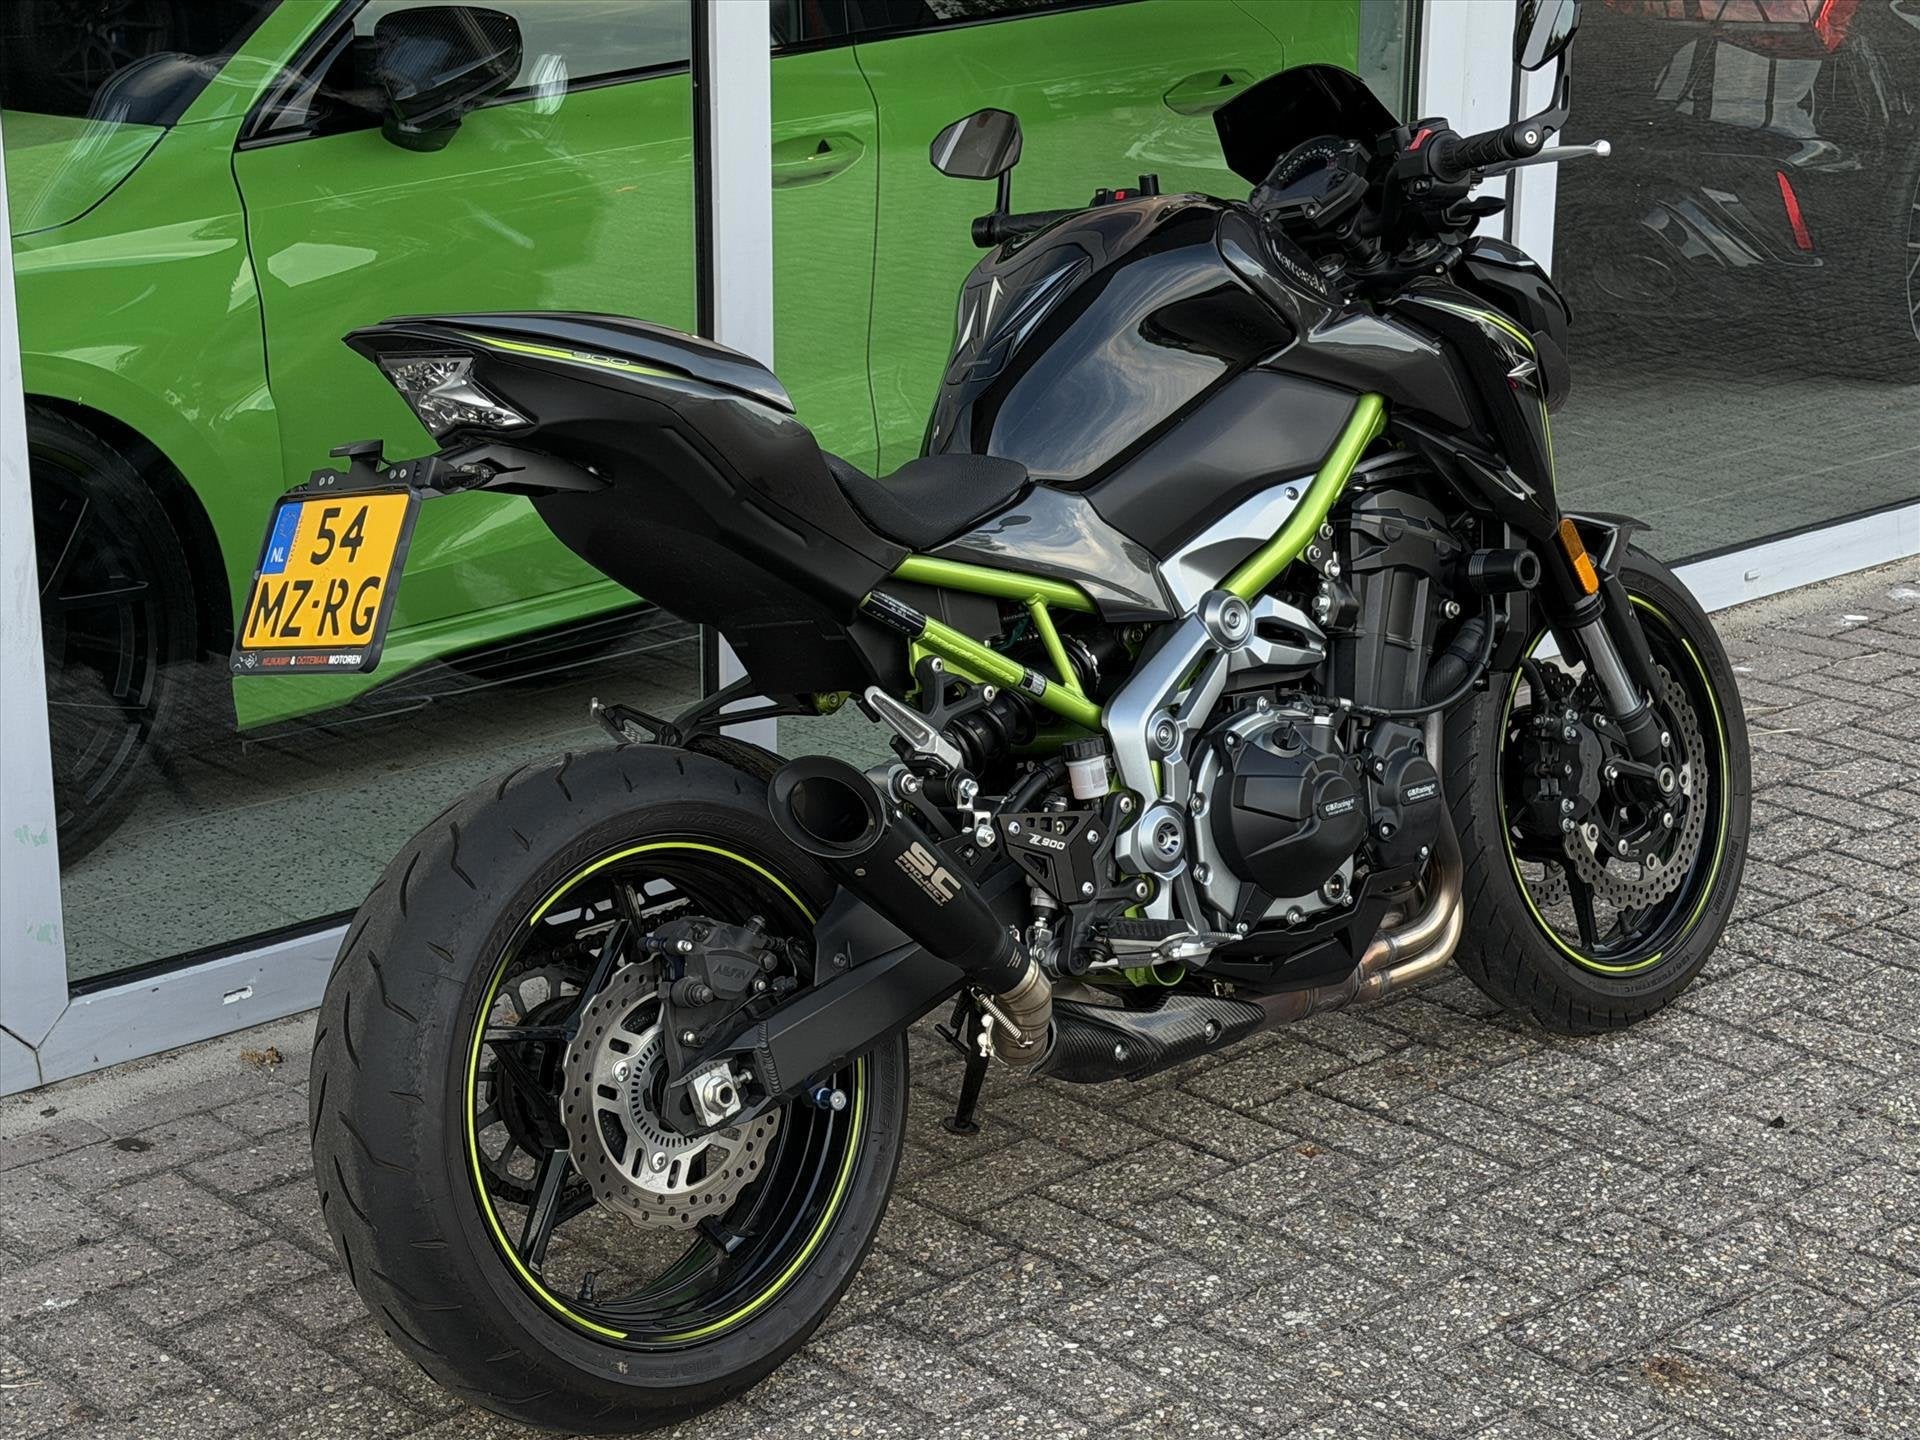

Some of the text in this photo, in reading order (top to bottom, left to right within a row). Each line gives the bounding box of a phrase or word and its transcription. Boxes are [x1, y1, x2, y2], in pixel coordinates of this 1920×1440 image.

[270, 547, 284, 563] NL
[310, 505, 369, 566] 54
[248, 575, 382, 639] MZ-RG
[290, 655, 296, 665] &
[328, 654, 362, 665] MOTOREN
[1028, 832, 1066, 850] Z900
[897, 854, 949, 903] PROJECT
[902, 841, 962, 900] SC
